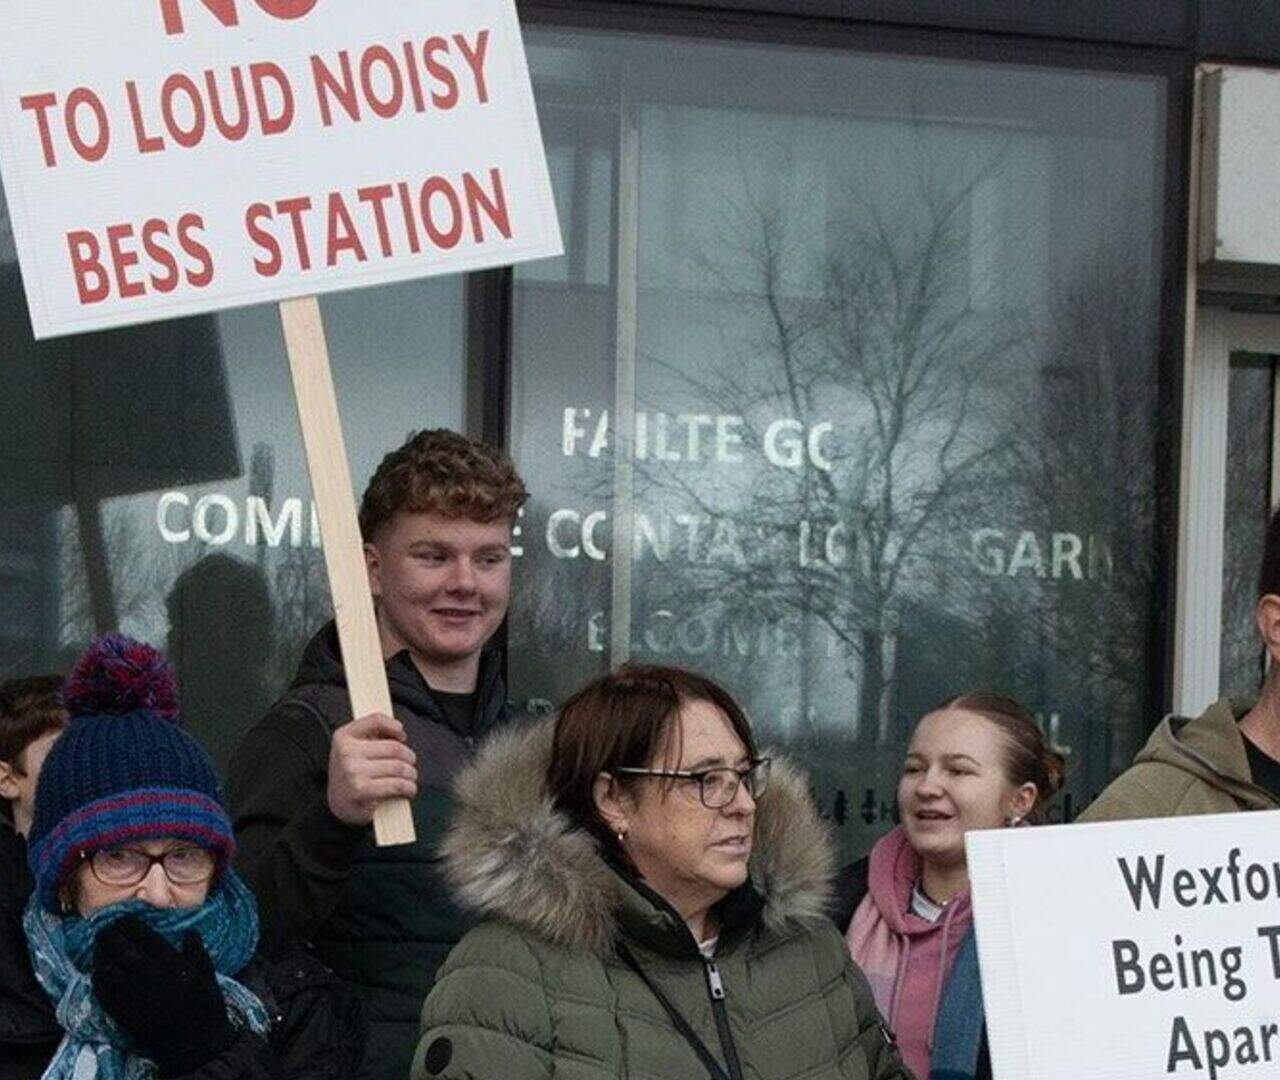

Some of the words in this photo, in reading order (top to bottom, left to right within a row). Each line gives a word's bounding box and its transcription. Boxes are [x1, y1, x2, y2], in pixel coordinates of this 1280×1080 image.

[21, 86, 110, 167] TO
[125, 61, 294, 153] LOUD
[310, 30, 490, 126] NOISY
[66, 213, 214, 304] BESS
[246, 168, 512, 277] STATION
[1111, 935, 1247, 1001] Being
